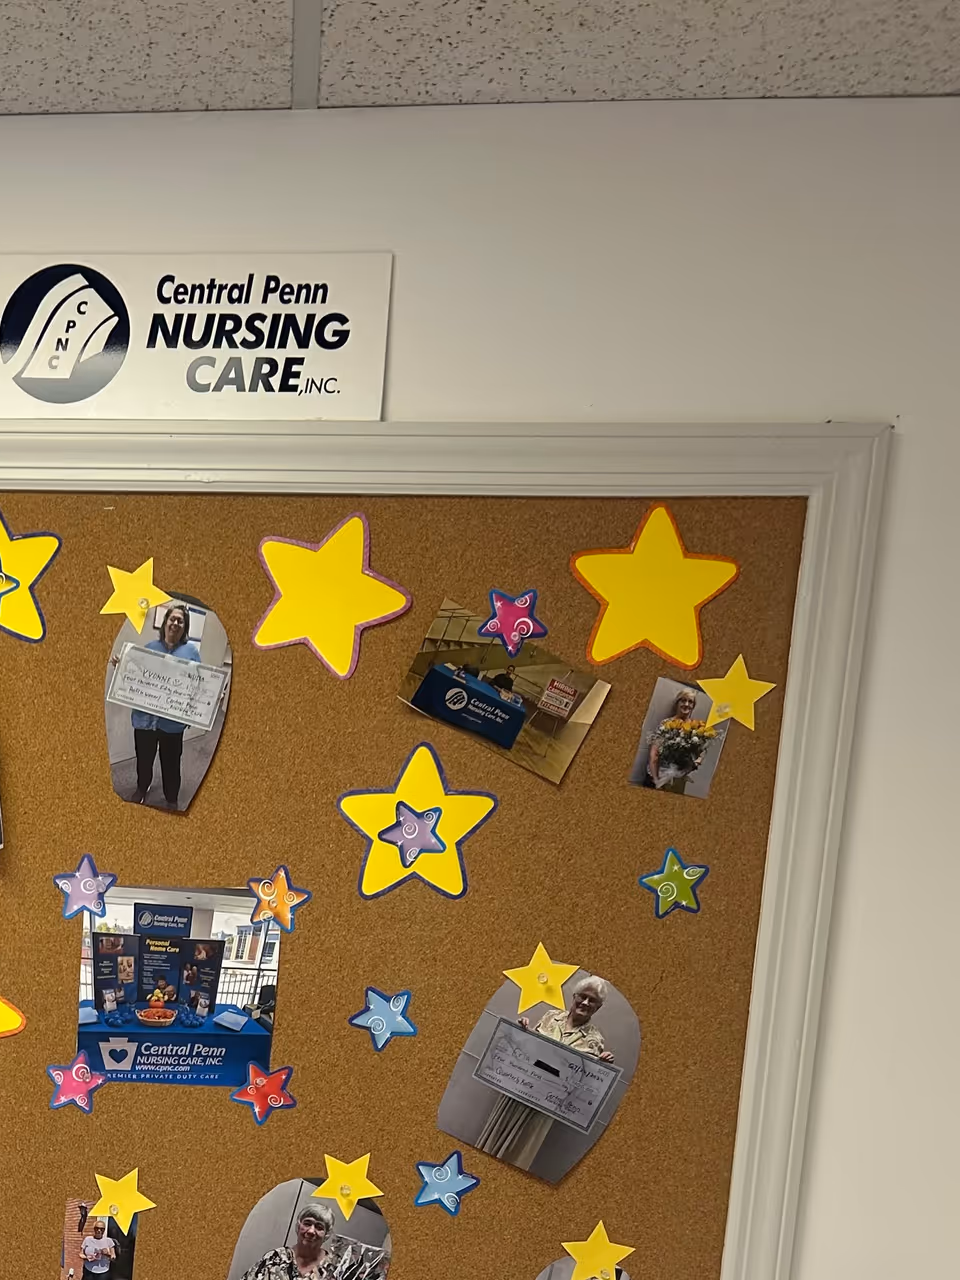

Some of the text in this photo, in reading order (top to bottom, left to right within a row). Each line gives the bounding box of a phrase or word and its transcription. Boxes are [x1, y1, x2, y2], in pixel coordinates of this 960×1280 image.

[155, 272, 329, 306] Central Penn
[145, 312, 351, 351] NURSING
[470, 698, 496, 712] Central
[154, 914, 174, 922] Central
[145, 938, 171, 947] Personal
[149, 945, 166, 953] Home
[140, 1042, 226, 1057] Central Penn
[136, 1056, 223, 1066] NURSING CARE, INC.
[135, 1064, 191, 1072] www.cpnc.com
